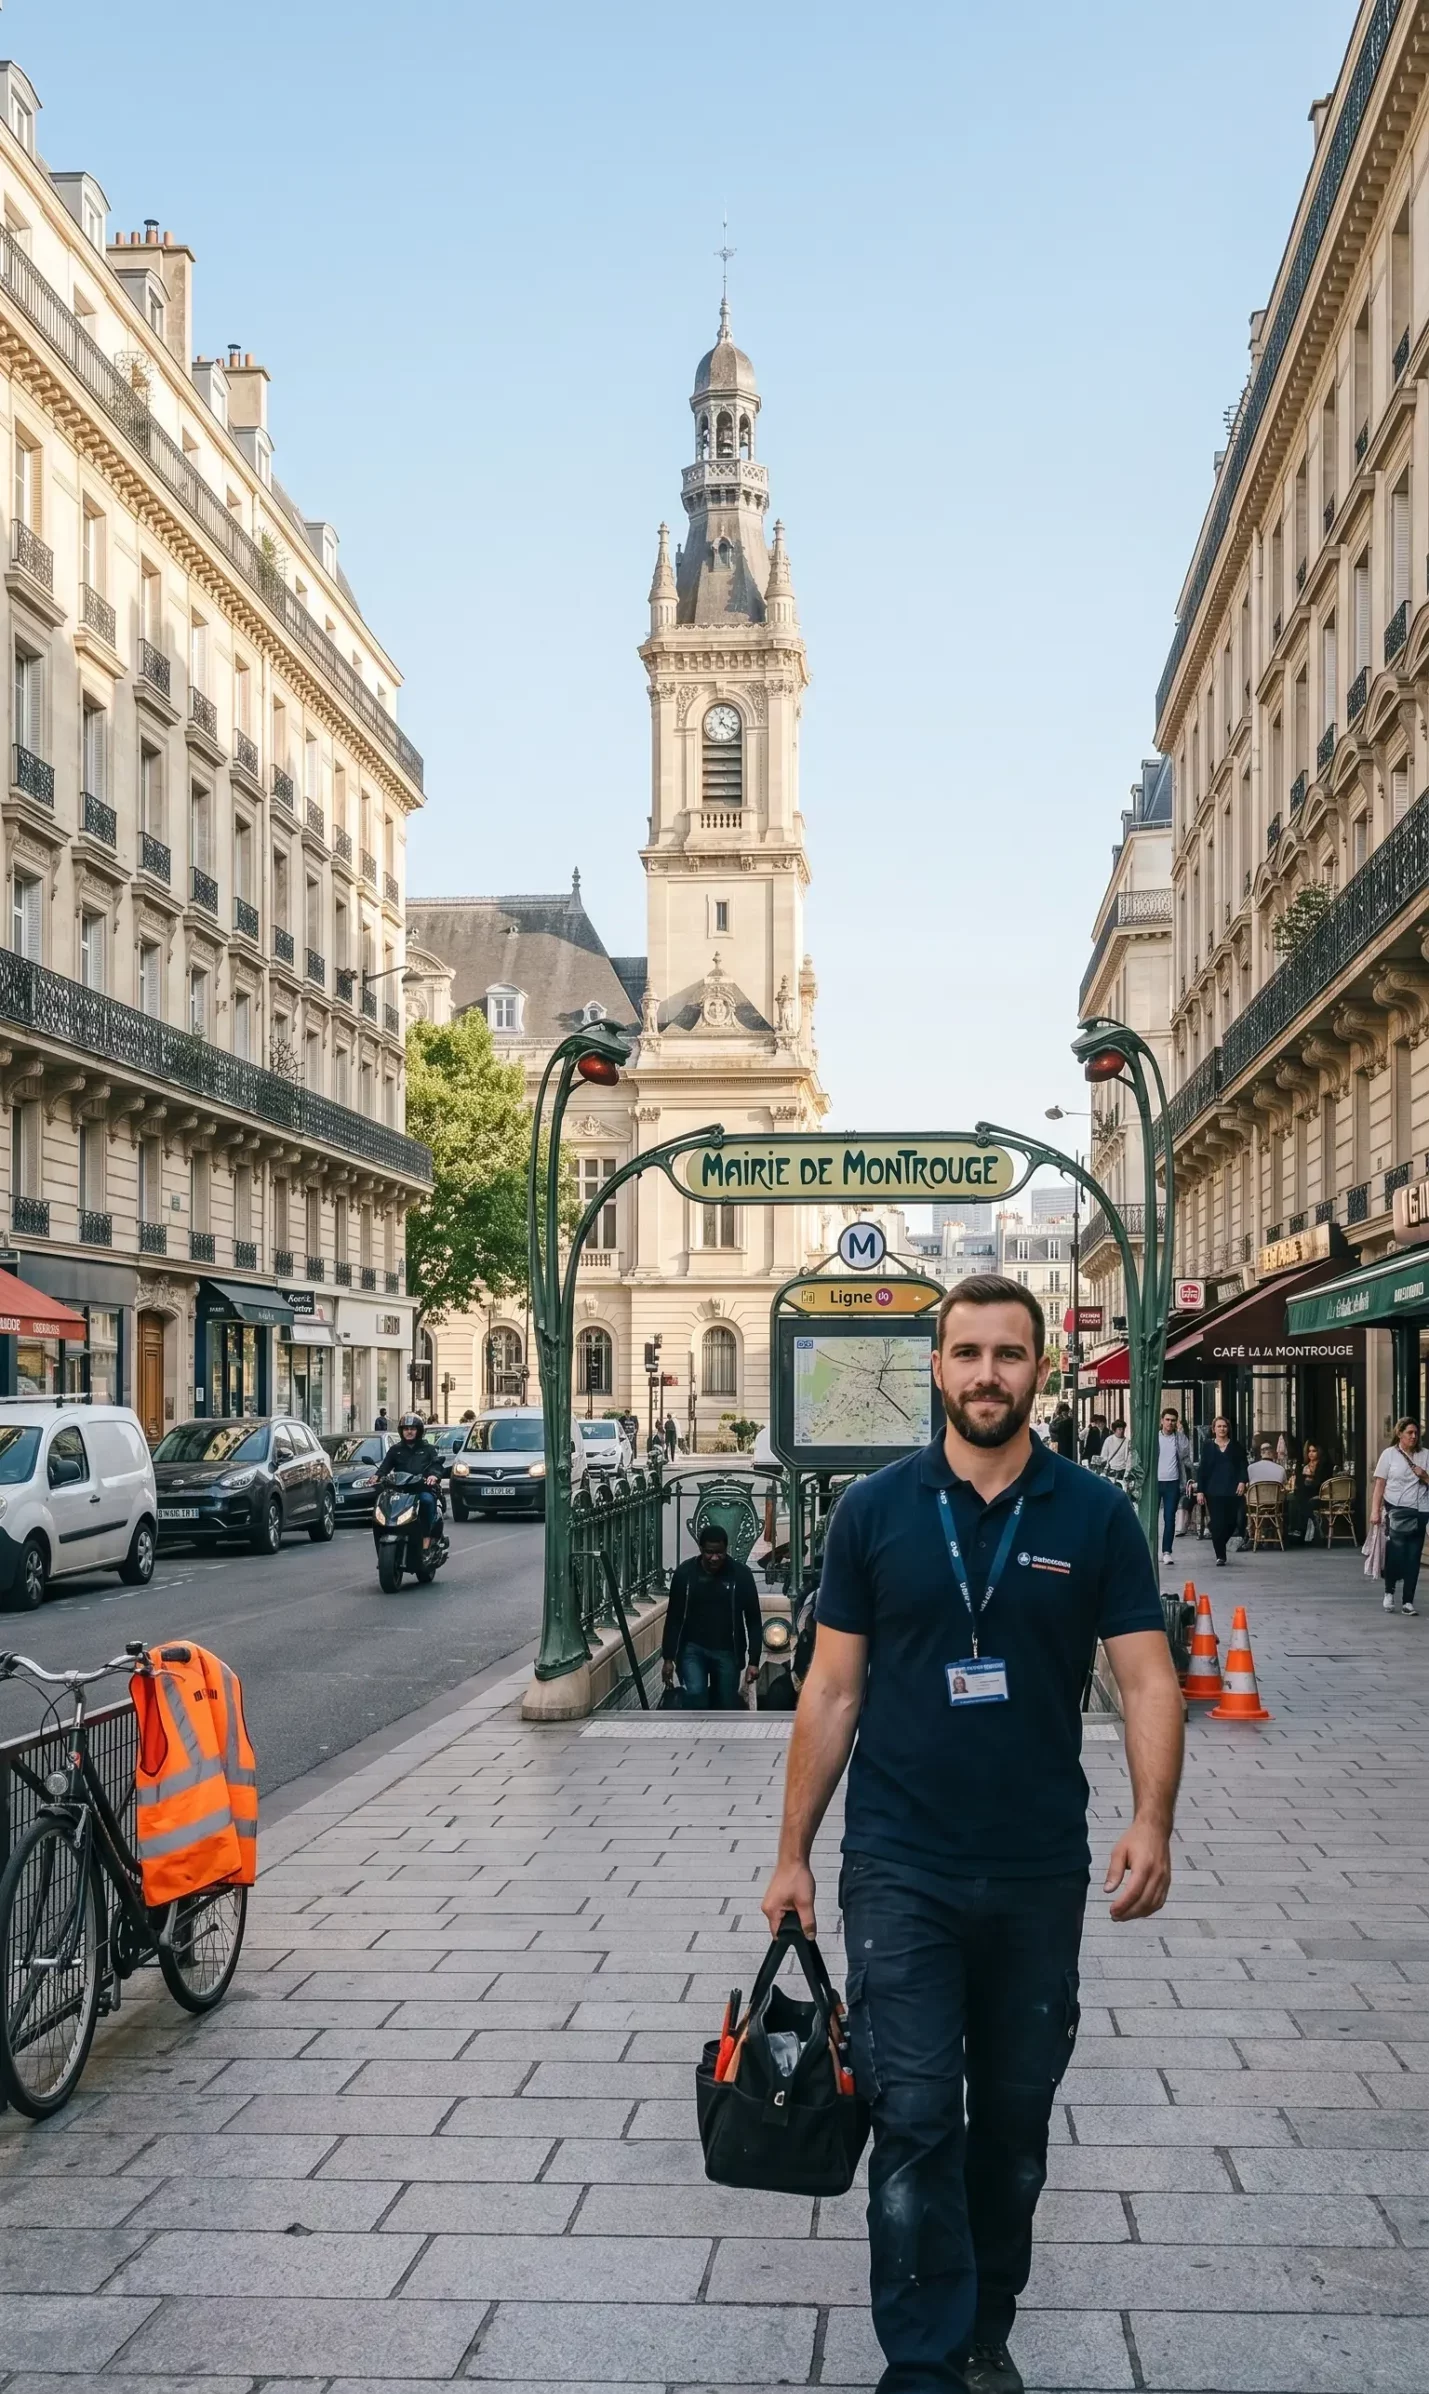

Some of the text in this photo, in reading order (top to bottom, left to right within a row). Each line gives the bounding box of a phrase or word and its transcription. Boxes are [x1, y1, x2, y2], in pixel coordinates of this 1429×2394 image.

[800, 1158, 833, 1185] DE
[843, 1150, 998, 1190] MONTROUGE
[849, 1232, 875, 1260] M
[830, 1290, 873, 1307] Ligne
[1213, 1344, 1245, 1357] CAFÉ
[1275, 1345, 1354, 1356] MONTROUGE
